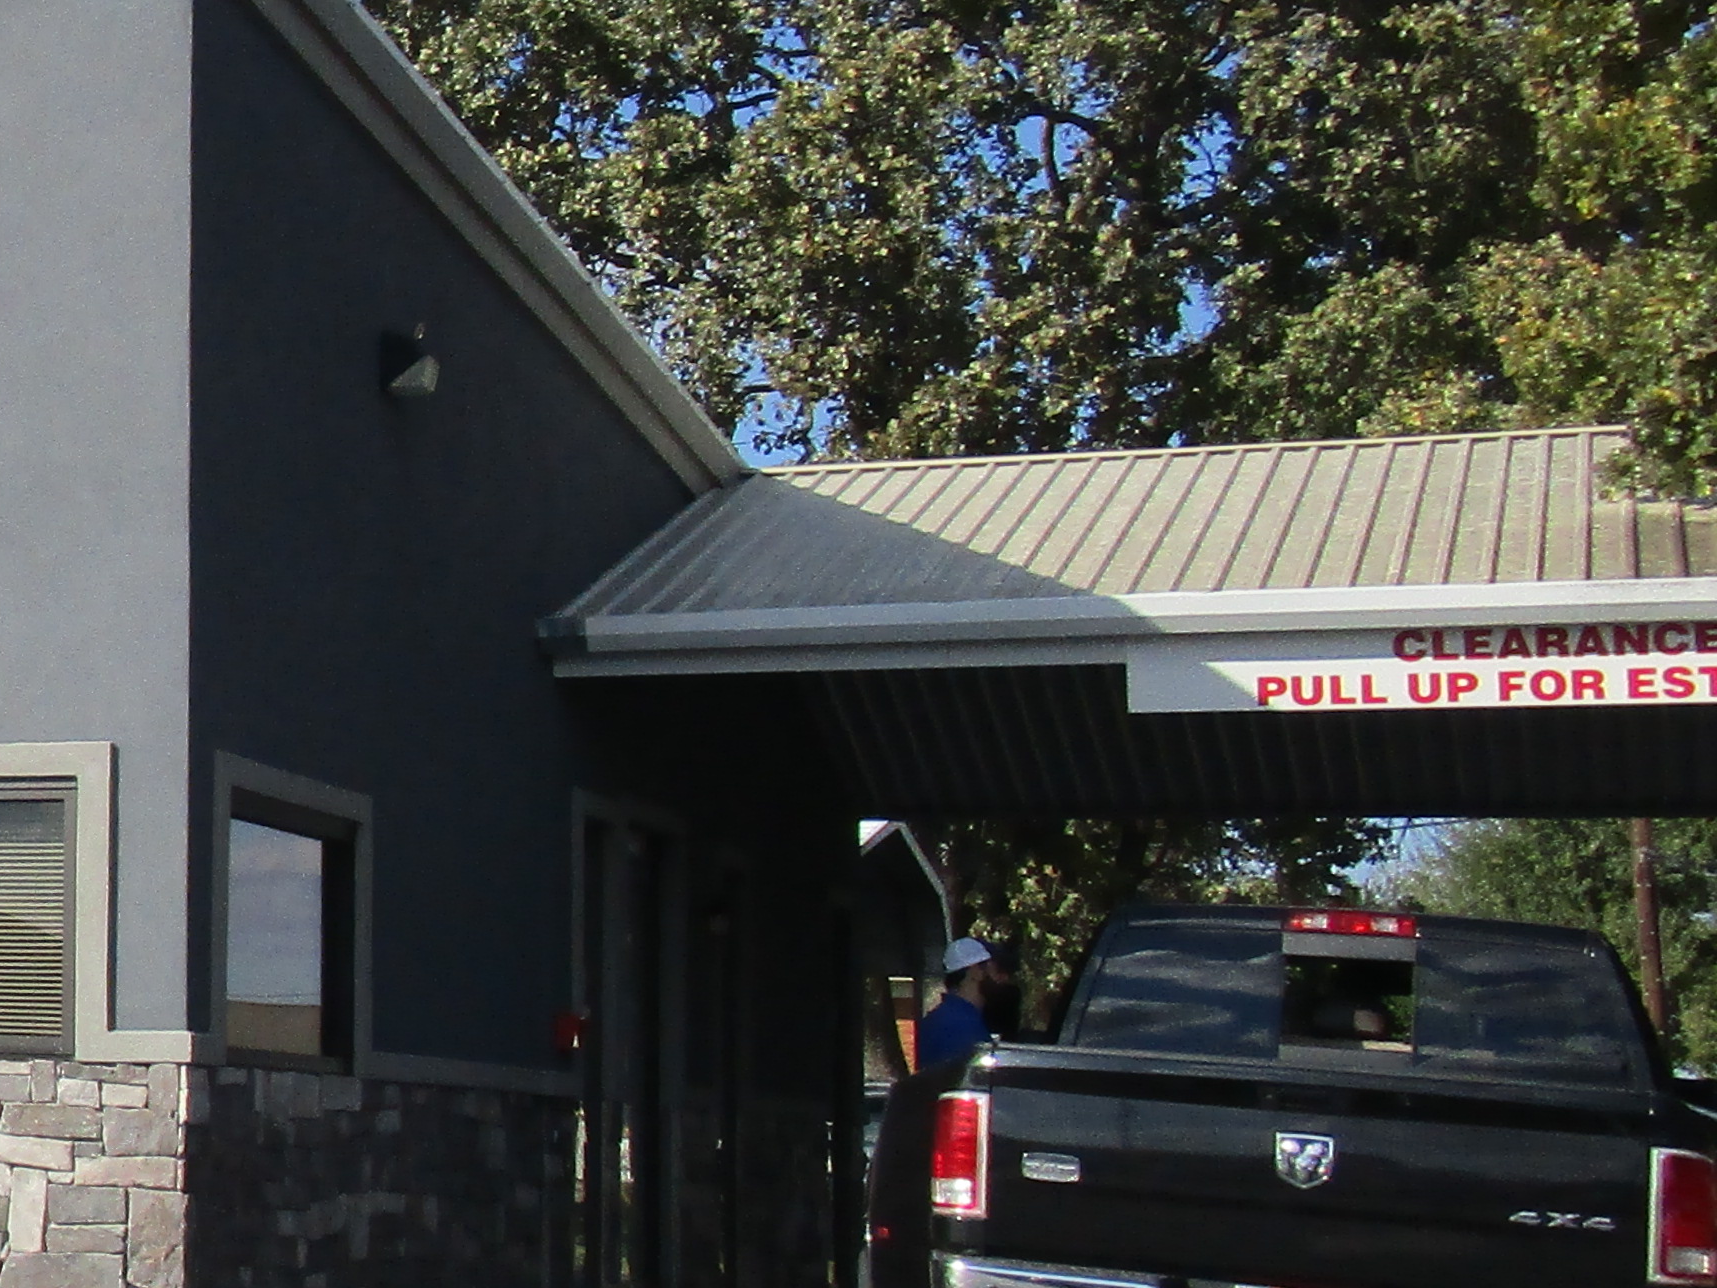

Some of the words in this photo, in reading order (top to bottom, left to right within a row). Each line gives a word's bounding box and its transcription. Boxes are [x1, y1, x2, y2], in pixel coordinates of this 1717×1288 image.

[1392, 621, 1717, 661] CLEARANCE
[1257, 674, 1388, 707] PULL
[1407, 671, 1479, 704] UP
[1498, 668, 1606, 701] FOR
